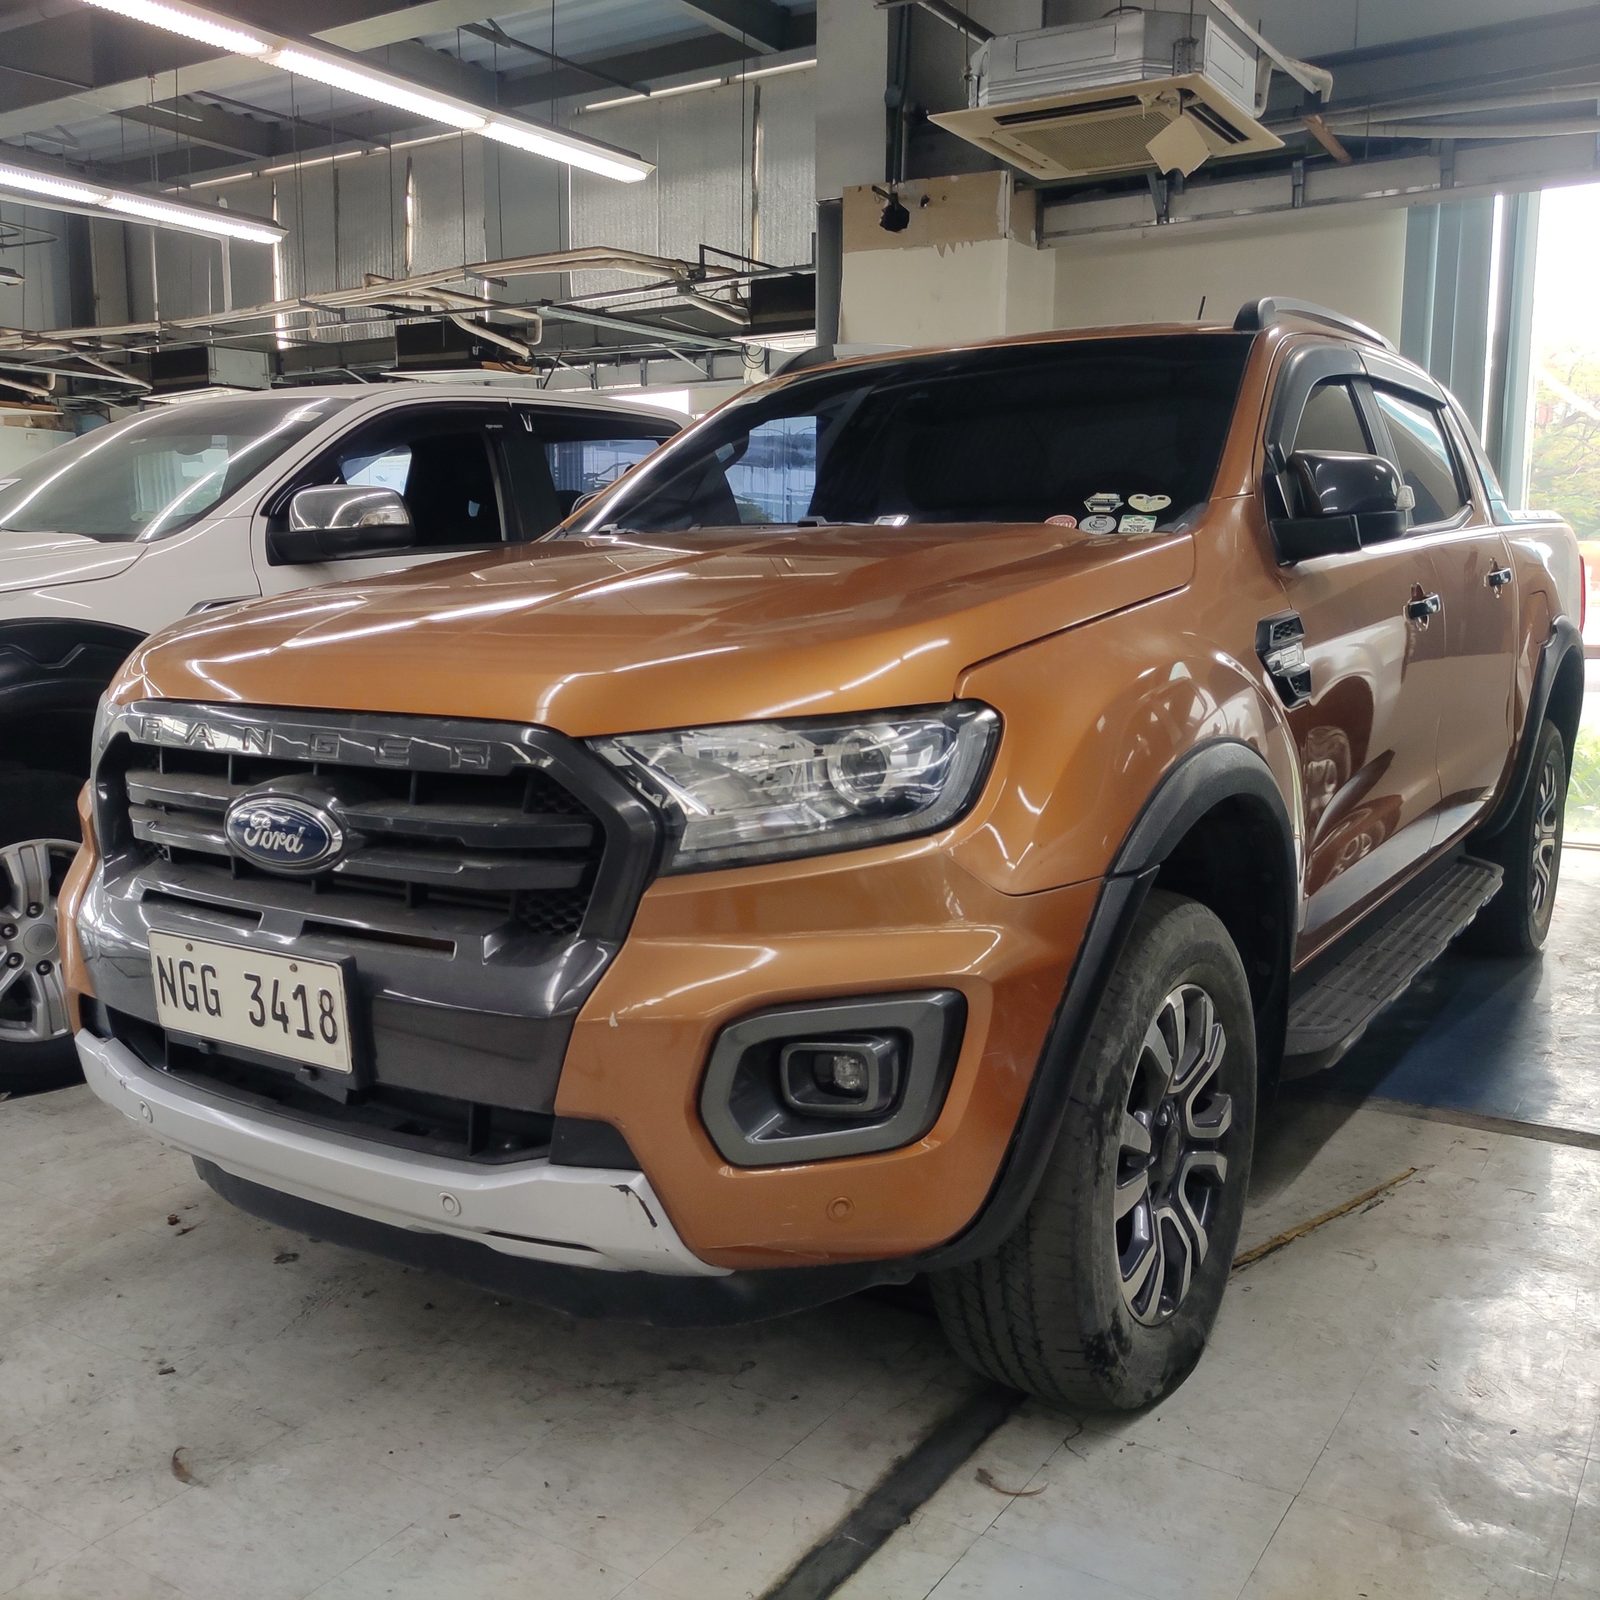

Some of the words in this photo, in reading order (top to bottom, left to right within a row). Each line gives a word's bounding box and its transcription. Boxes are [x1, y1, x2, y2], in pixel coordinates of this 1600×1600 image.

[140, 716, 492, 770] RANGER
[243, 808, 306, 854] Ford
[156, 955, 222, 1018] NGG
[243, 972, 338, 1045] 3418
